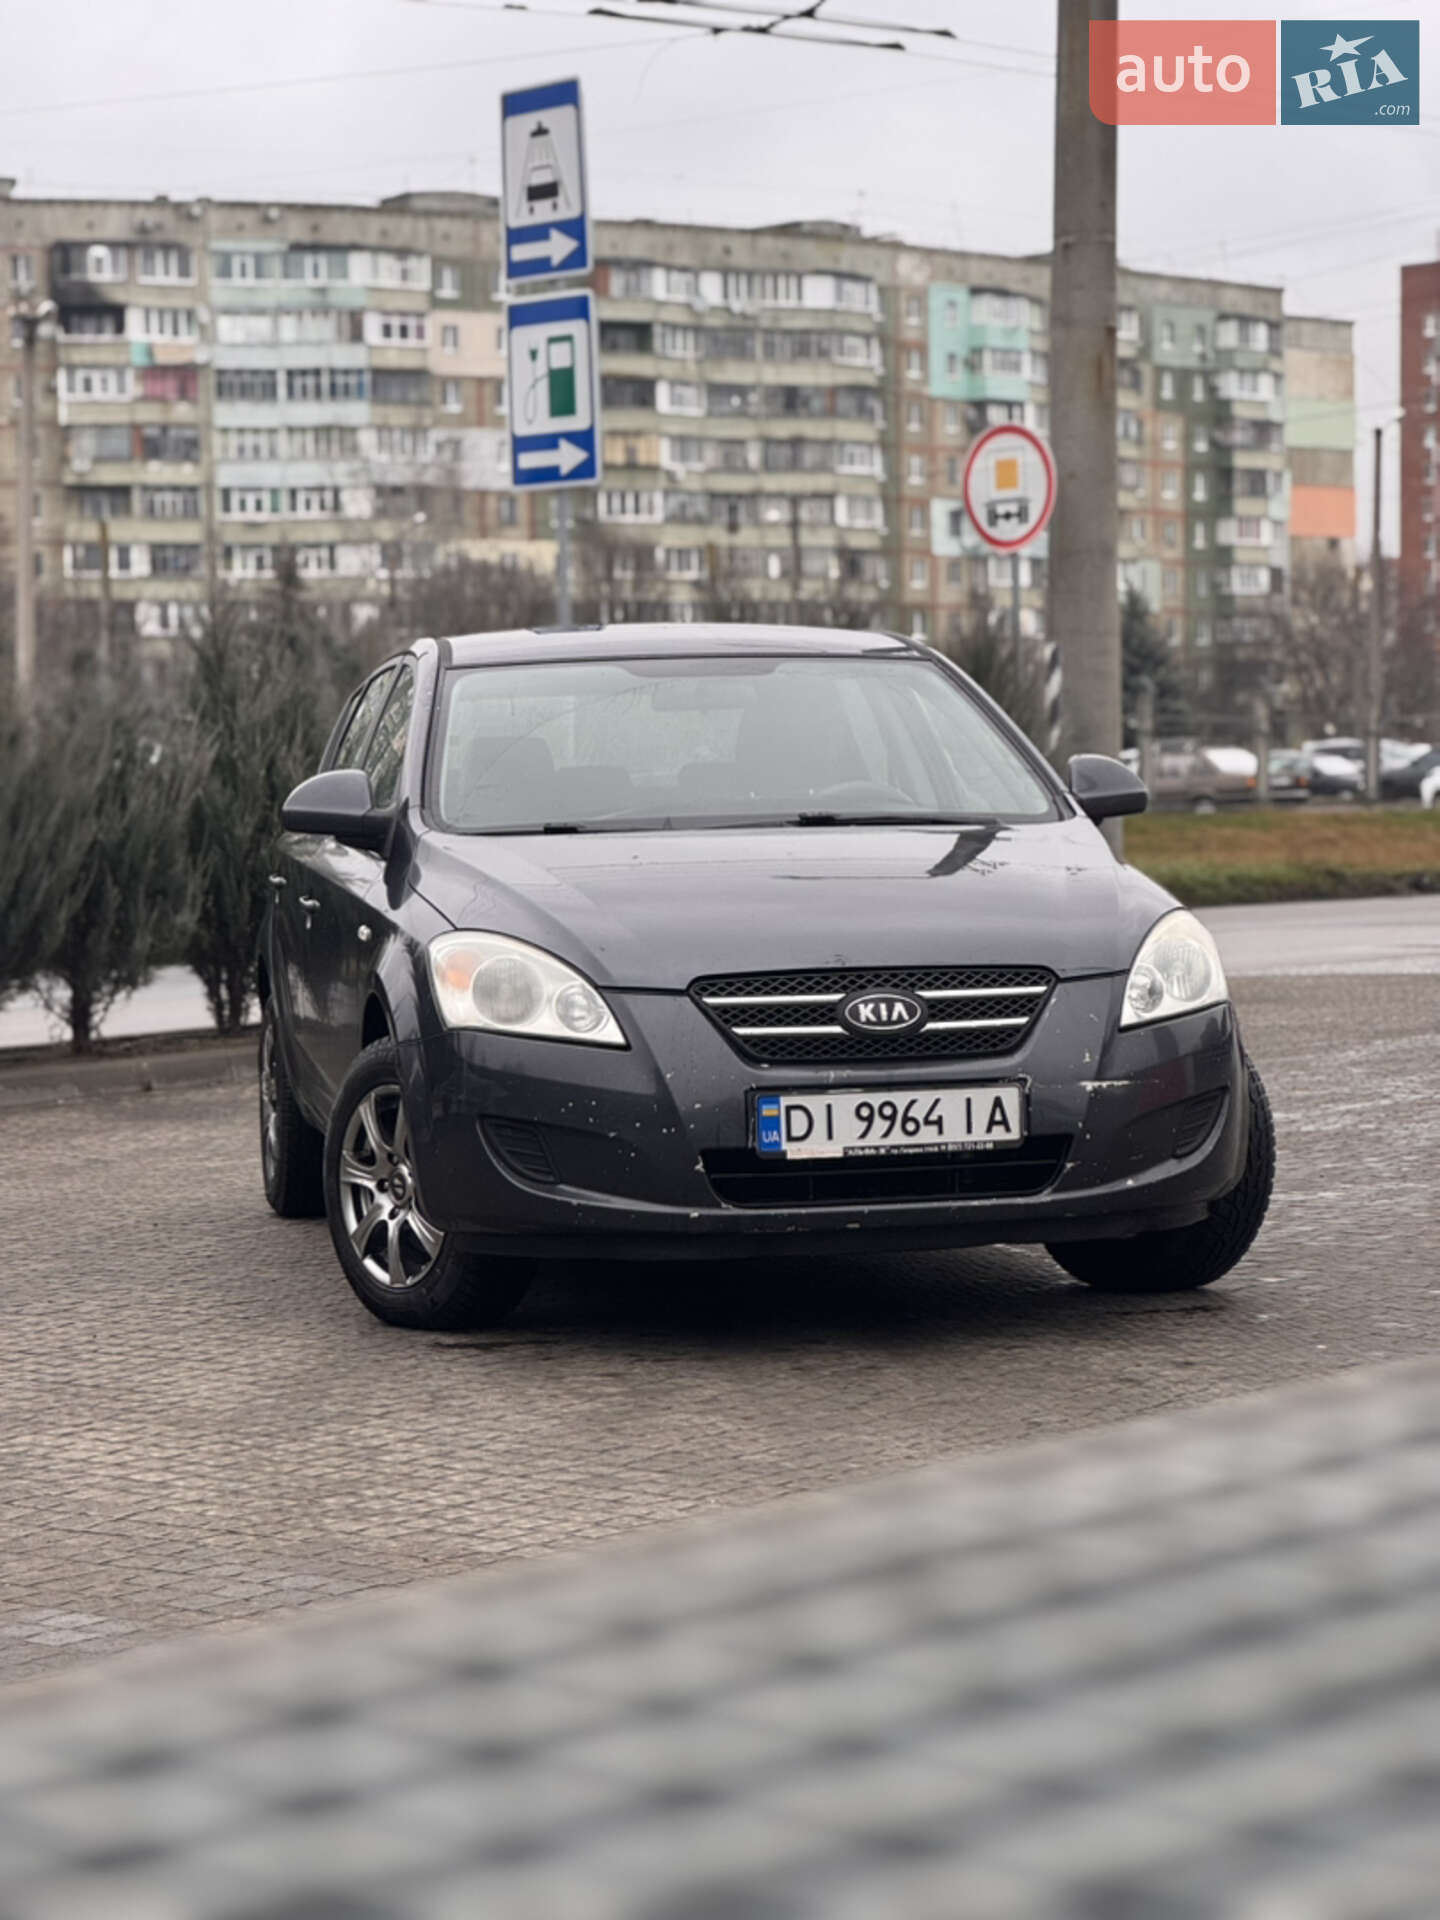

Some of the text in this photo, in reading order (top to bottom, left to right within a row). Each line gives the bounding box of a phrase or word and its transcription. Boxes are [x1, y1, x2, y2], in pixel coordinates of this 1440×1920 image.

[857, 1002, 909, 1022] KIA
[785, 1096, 1012, 1142] DI 9964 IA
[762, 1130, 780, 1143] UA
